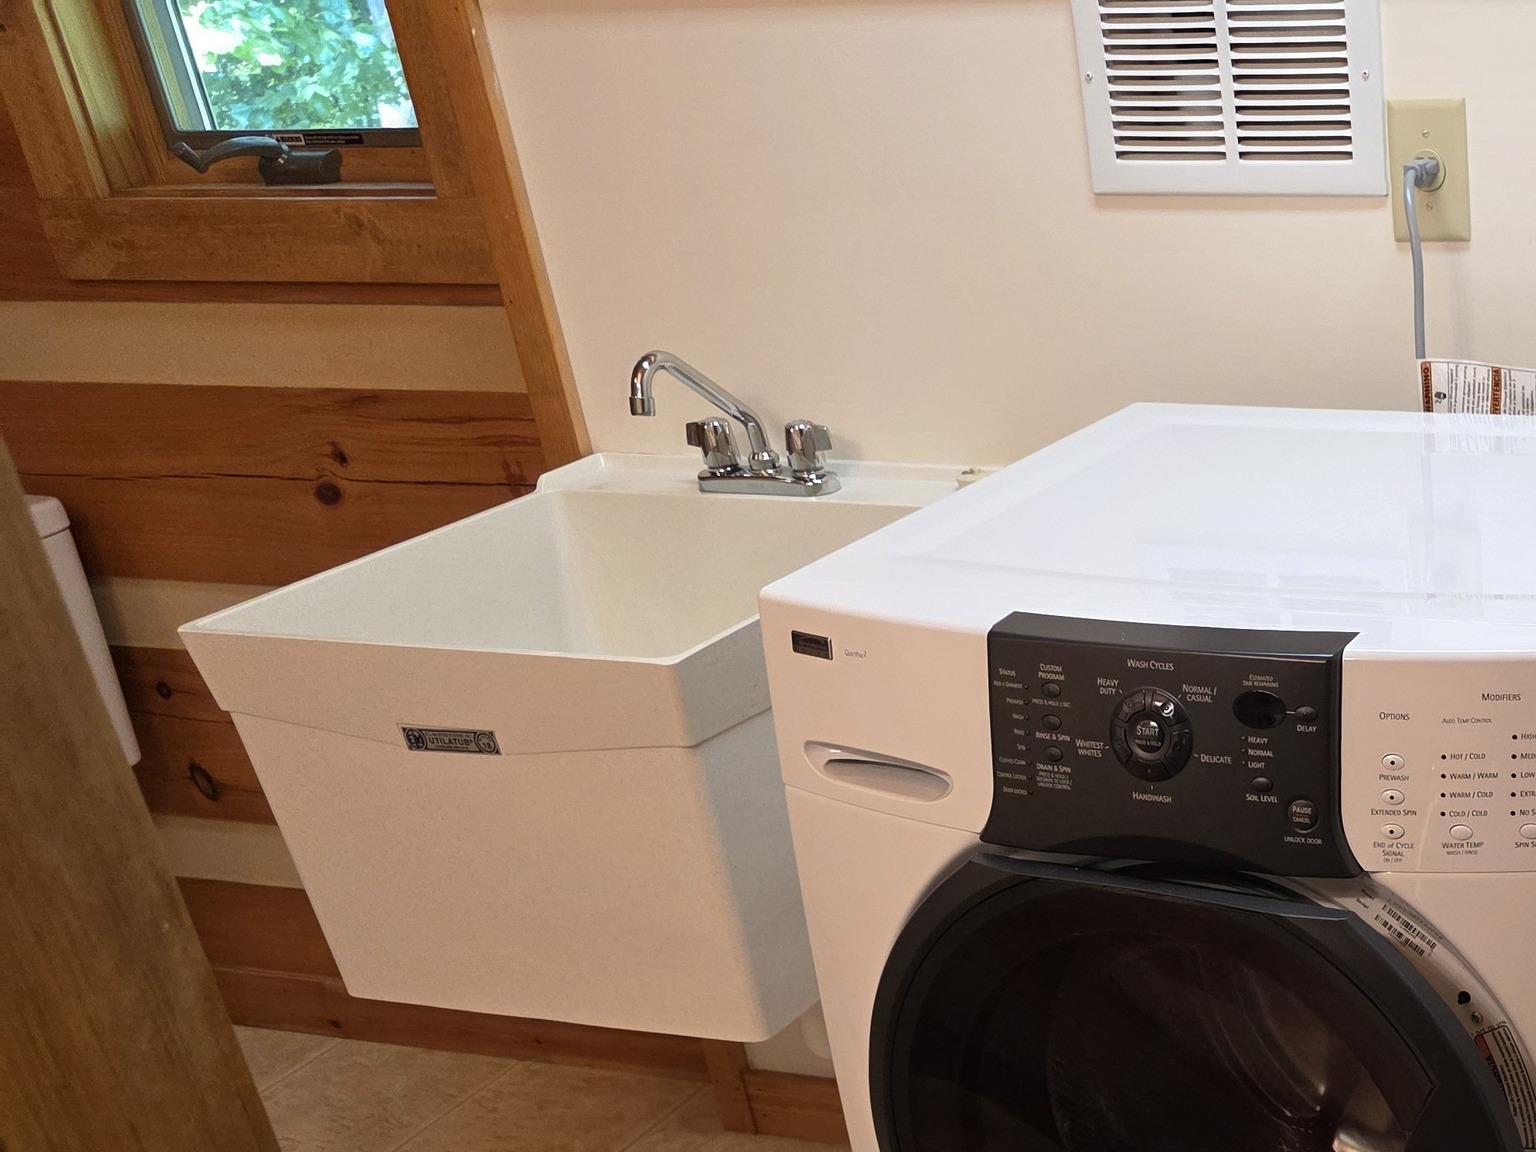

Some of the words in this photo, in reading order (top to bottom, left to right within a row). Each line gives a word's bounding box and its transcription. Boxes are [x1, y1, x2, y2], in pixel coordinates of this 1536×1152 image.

[1492, 369, 1501, 414] VERTENCIA
[1040, 663, 1062, 672] CUSTOM
[1127, 659, 1148, 669] WASH
[1150, 661, 1174, 671] CYCLES
[1038, 672, 1064, 680] PROGRAM
[1097, 678, 1119, 687] HEAVY
[1100, 687, 1116, 695] DUTY
[1183, 684, 1212, 694] NORMAL
[1187, 694, 1213, 703] CASUAL
[1481, 692, 1521, 702] MODIFIERS
[1379, 712, 1410, 720] OPTIONS
[1136, 726, 1159, 736] START
[1297, 724, 1317, 733] DELAY
[428, 737, 469, 746] UTILATUB
[1036, 732, 1050, 740] RINSE
[1058, 734, 1070, 742] SPIN
[1248, 736, 1268, 744] HEAVY
[1075, 739, 1103, 749] WHITEST
[1078, 749, 1102, 758] WHITES
[1248, 749, 1274, 757] NORMAL
[1201, 754, 1232, 764] DELICATE
[1037, 763, 1052, 772] DRAIN
[1248, 761, 1265, 769] LIGHT
[1133, 792, 1172, 802] HANDWASH
[1246, 794, 1259, 802] SOIL
[1261, 794, 1278, 803] LEVEL
[1292, 806, 1312, 814] PAUSE
[1293, 816, 1311, 824] CANCEL
[1284, 836, 1305, 844] UNLOCK
